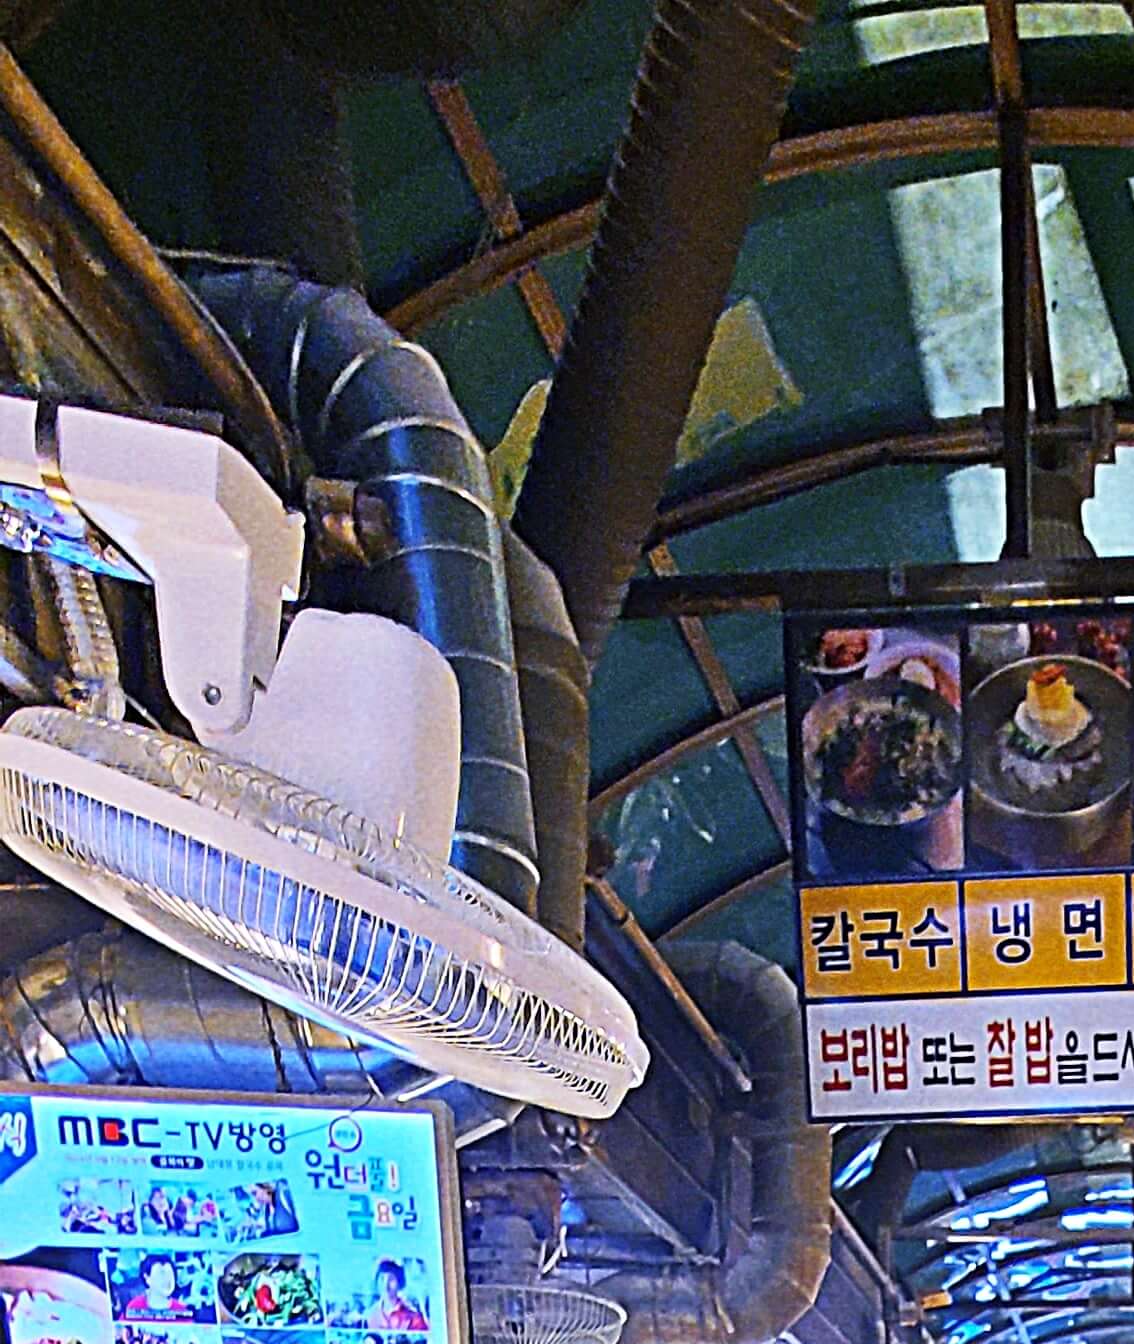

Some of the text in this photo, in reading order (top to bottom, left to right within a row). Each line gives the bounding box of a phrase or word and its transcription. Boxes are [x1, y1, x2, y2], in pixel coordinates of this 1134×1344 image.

[811, 908, 954, 972] 칼국수
[820, 1022, 910, 1093] 보리밥
[922, 1031, 977, 1087] 또는
[347, 1194, 419, 1241] 금요일
